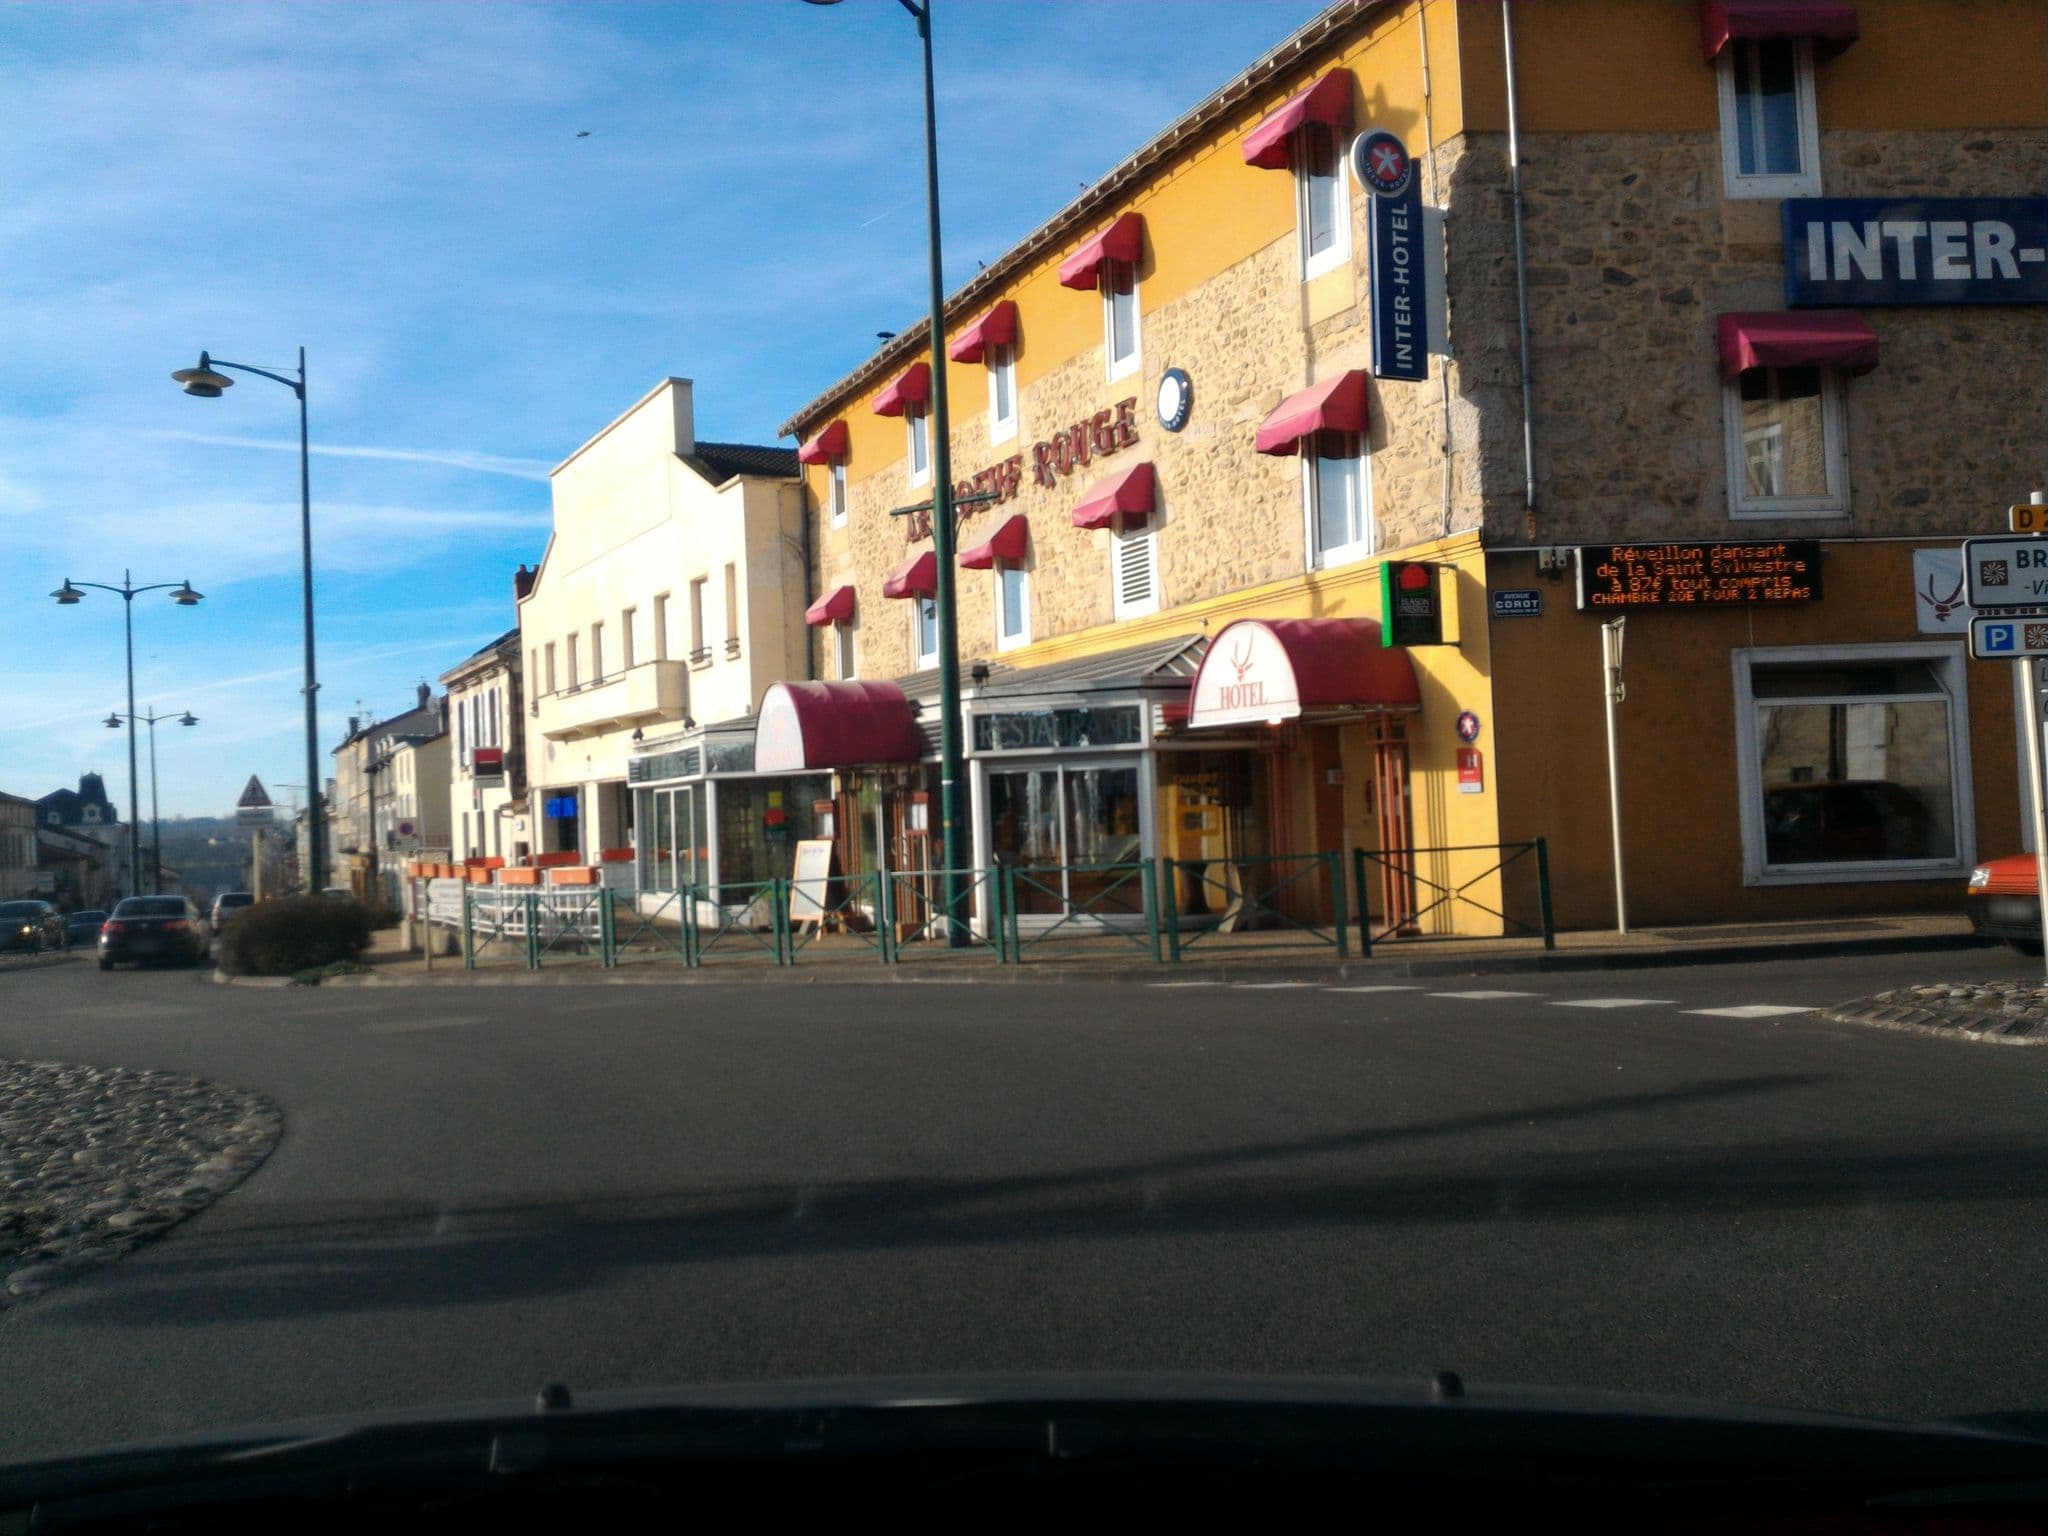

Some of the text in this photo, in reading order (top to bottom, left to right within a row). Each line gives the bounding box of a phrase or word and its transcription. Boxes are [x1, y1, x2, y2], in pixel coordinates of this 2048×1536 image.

[1806, 220, 2046, 281] INTER-
[1391, 203, 1413, 369] INTER-HOTEL
[1032, 396, 1140, 491] ROUGE
[1710, 544, 1786, 559] dansant
[1597, 559, 1807, 577] de la Saint Sylvestre
[1671, 577, 1711, 590] tout
[1719, 576, 1792, 589] compris
[1496, 600, 1538, 609] COROT
[1592, 592, 1659, 604] CHAMBRE
[1703, 589, 1740, 601] POUR
[1748, 588, 1757, 600] 2
[1764, 587, 1811, 599] REPAS
[1220, 682, 1268, 709] HOTEL
[979, 710, 1136, 747] RESTAURANT
